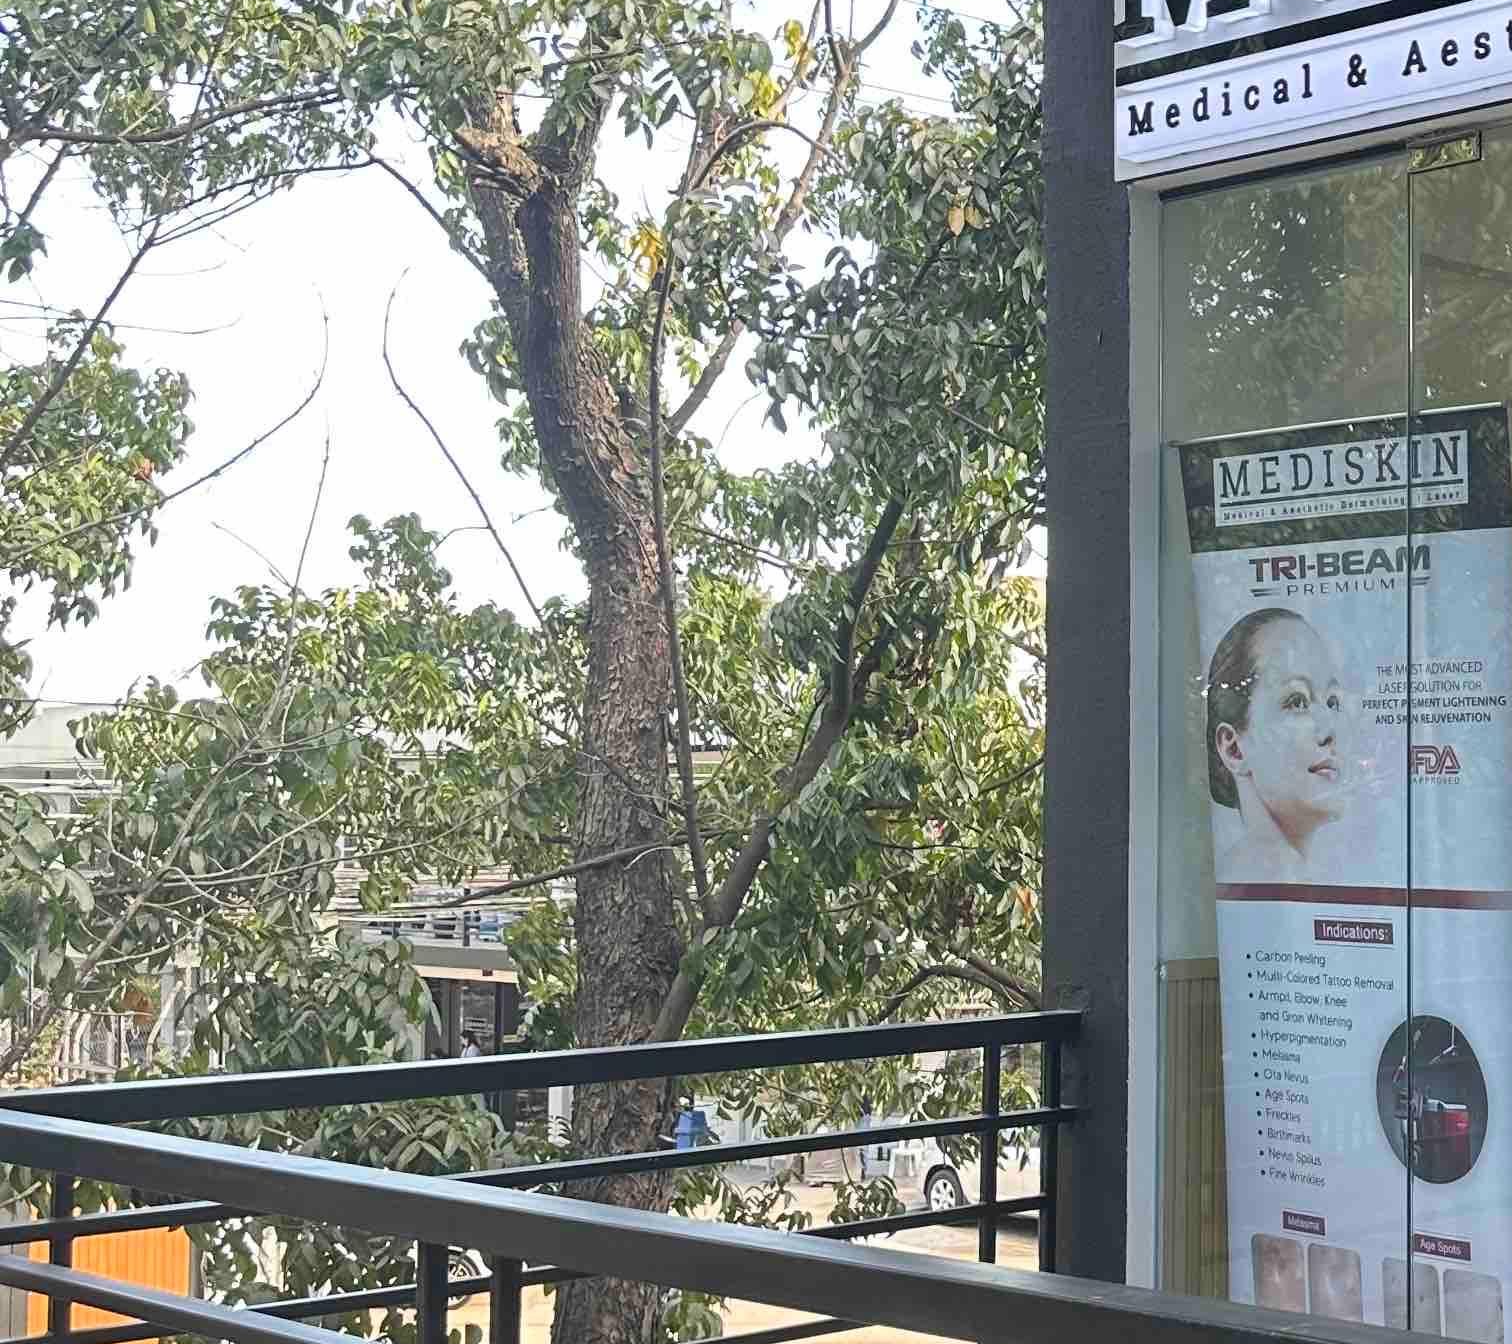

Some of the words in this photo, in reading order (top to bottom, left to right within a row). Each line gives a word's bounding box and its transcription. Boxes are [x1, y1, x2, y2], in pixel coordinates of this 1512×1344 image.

[1128, 63, 1314, 136] Medical
[1347, 53, 1368, 88] &
[1219, 435, 1461, 499] MEDISKIN
[1249, 544, 1431, 583] TRI-BEAM
[1286, 577, 1395, 597] PREMIUM
[1376, 665, 1393, 677] THE
[1425, 660, 1483, 675] ADVANCED
[1362, 698, 1400, 710] PERFECT
[1401, 697, 1441, 709] PGMENT
[1442, 695, 1508, 708] LIGHTENING
[1375, 714, 1395, 726] AND
[1396, 713, 1418, 725] SKN
[1420, 711, 1492, 724] REJUVENATION
[1410, 745, 1461, 775] FDA
[1321, 922, 1390, 942] Indications:
[1255, 949, 1292, 963] Carbon
[1354, 975, 1394, 991] Removal
[1259, 1009, 1279, 1022] and
[1260, 1028, 1347, 1049] Hyperpigmentation
[1265, 1087, 1284, 1103] Age
[1419, 1237, 1436, 1252] Age
[1437, 1240, 1462, 1256] Spots
